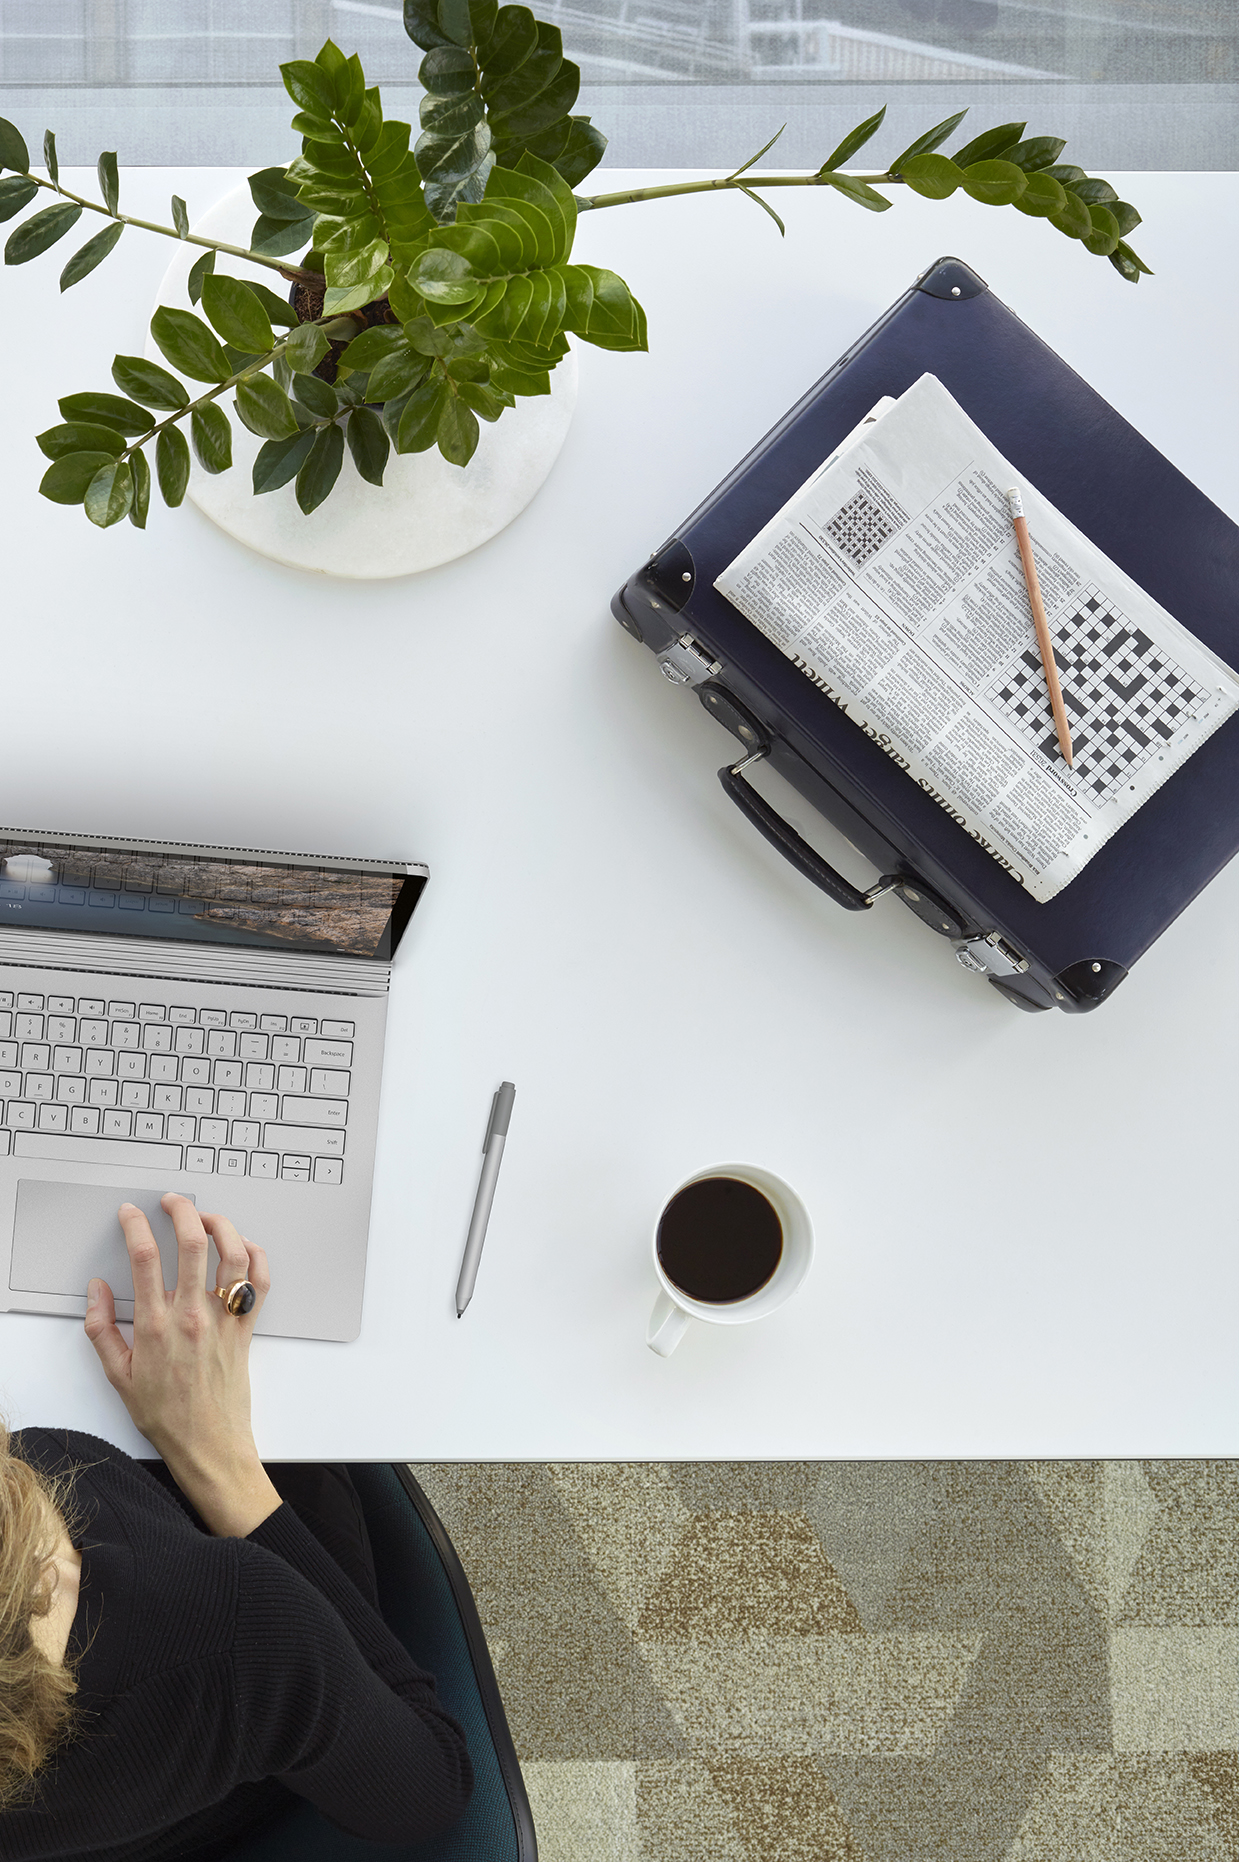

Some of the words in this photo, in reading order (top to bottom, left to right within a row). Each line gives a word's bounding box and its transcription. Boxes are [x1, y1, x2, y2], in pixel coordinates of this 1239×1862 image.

[901, 623, 914, 636] DOWN
[959, 681, 974, 695] ACROSS
[1045, 765, 1077, 796] Crossword
[320, 1049, 345, 1057] Backspace
